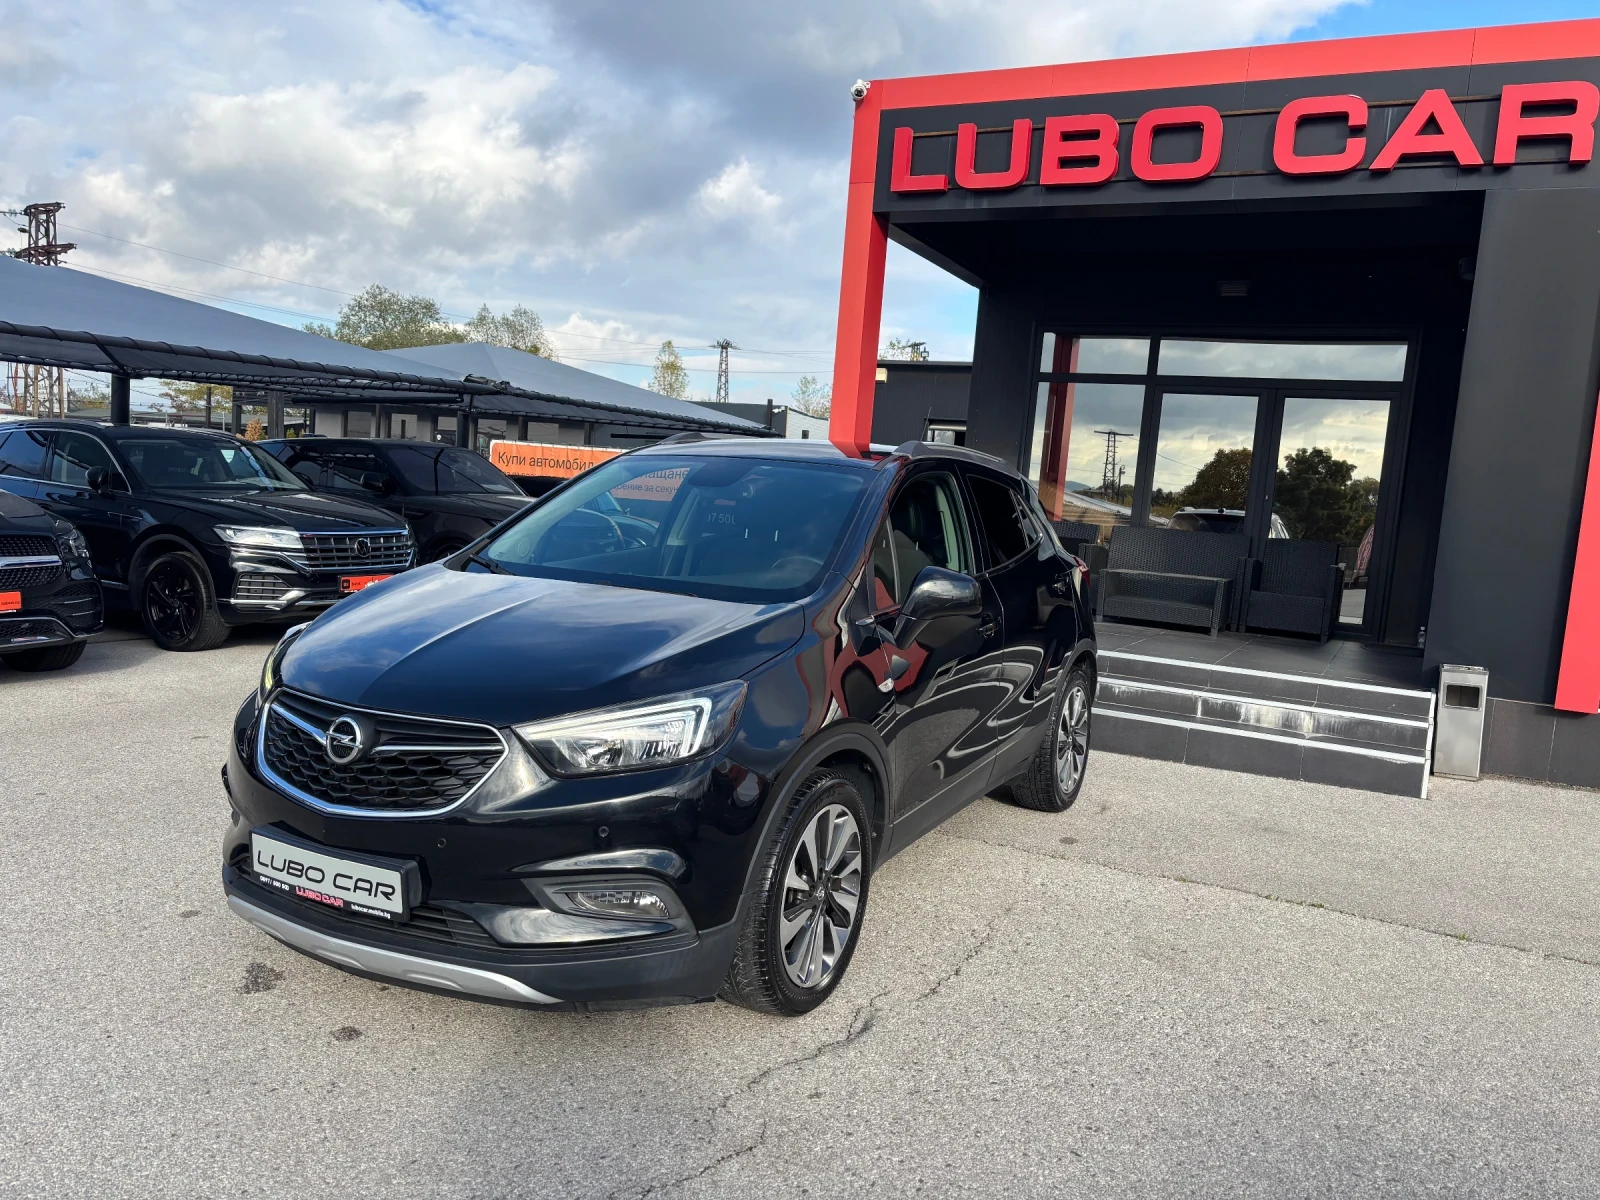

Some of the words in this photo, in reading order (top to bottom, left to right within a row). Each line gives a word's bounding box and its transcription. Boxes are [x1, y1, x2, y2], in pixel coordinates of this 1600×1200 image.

[890, 105, 1224, 194] LUBO
[1273, 80, 1600, 177] CAR
[498, 451, 526, 467] Купи
[529, 456, 594, 471] автомобил
[644, 484, 654, 492] за
[257, 850, 325, 884] LUBO
[332, 872, 396, 901] CAR
[295, 885, 322, 901] LUBO
[321, 894, 344, 908] CAR
